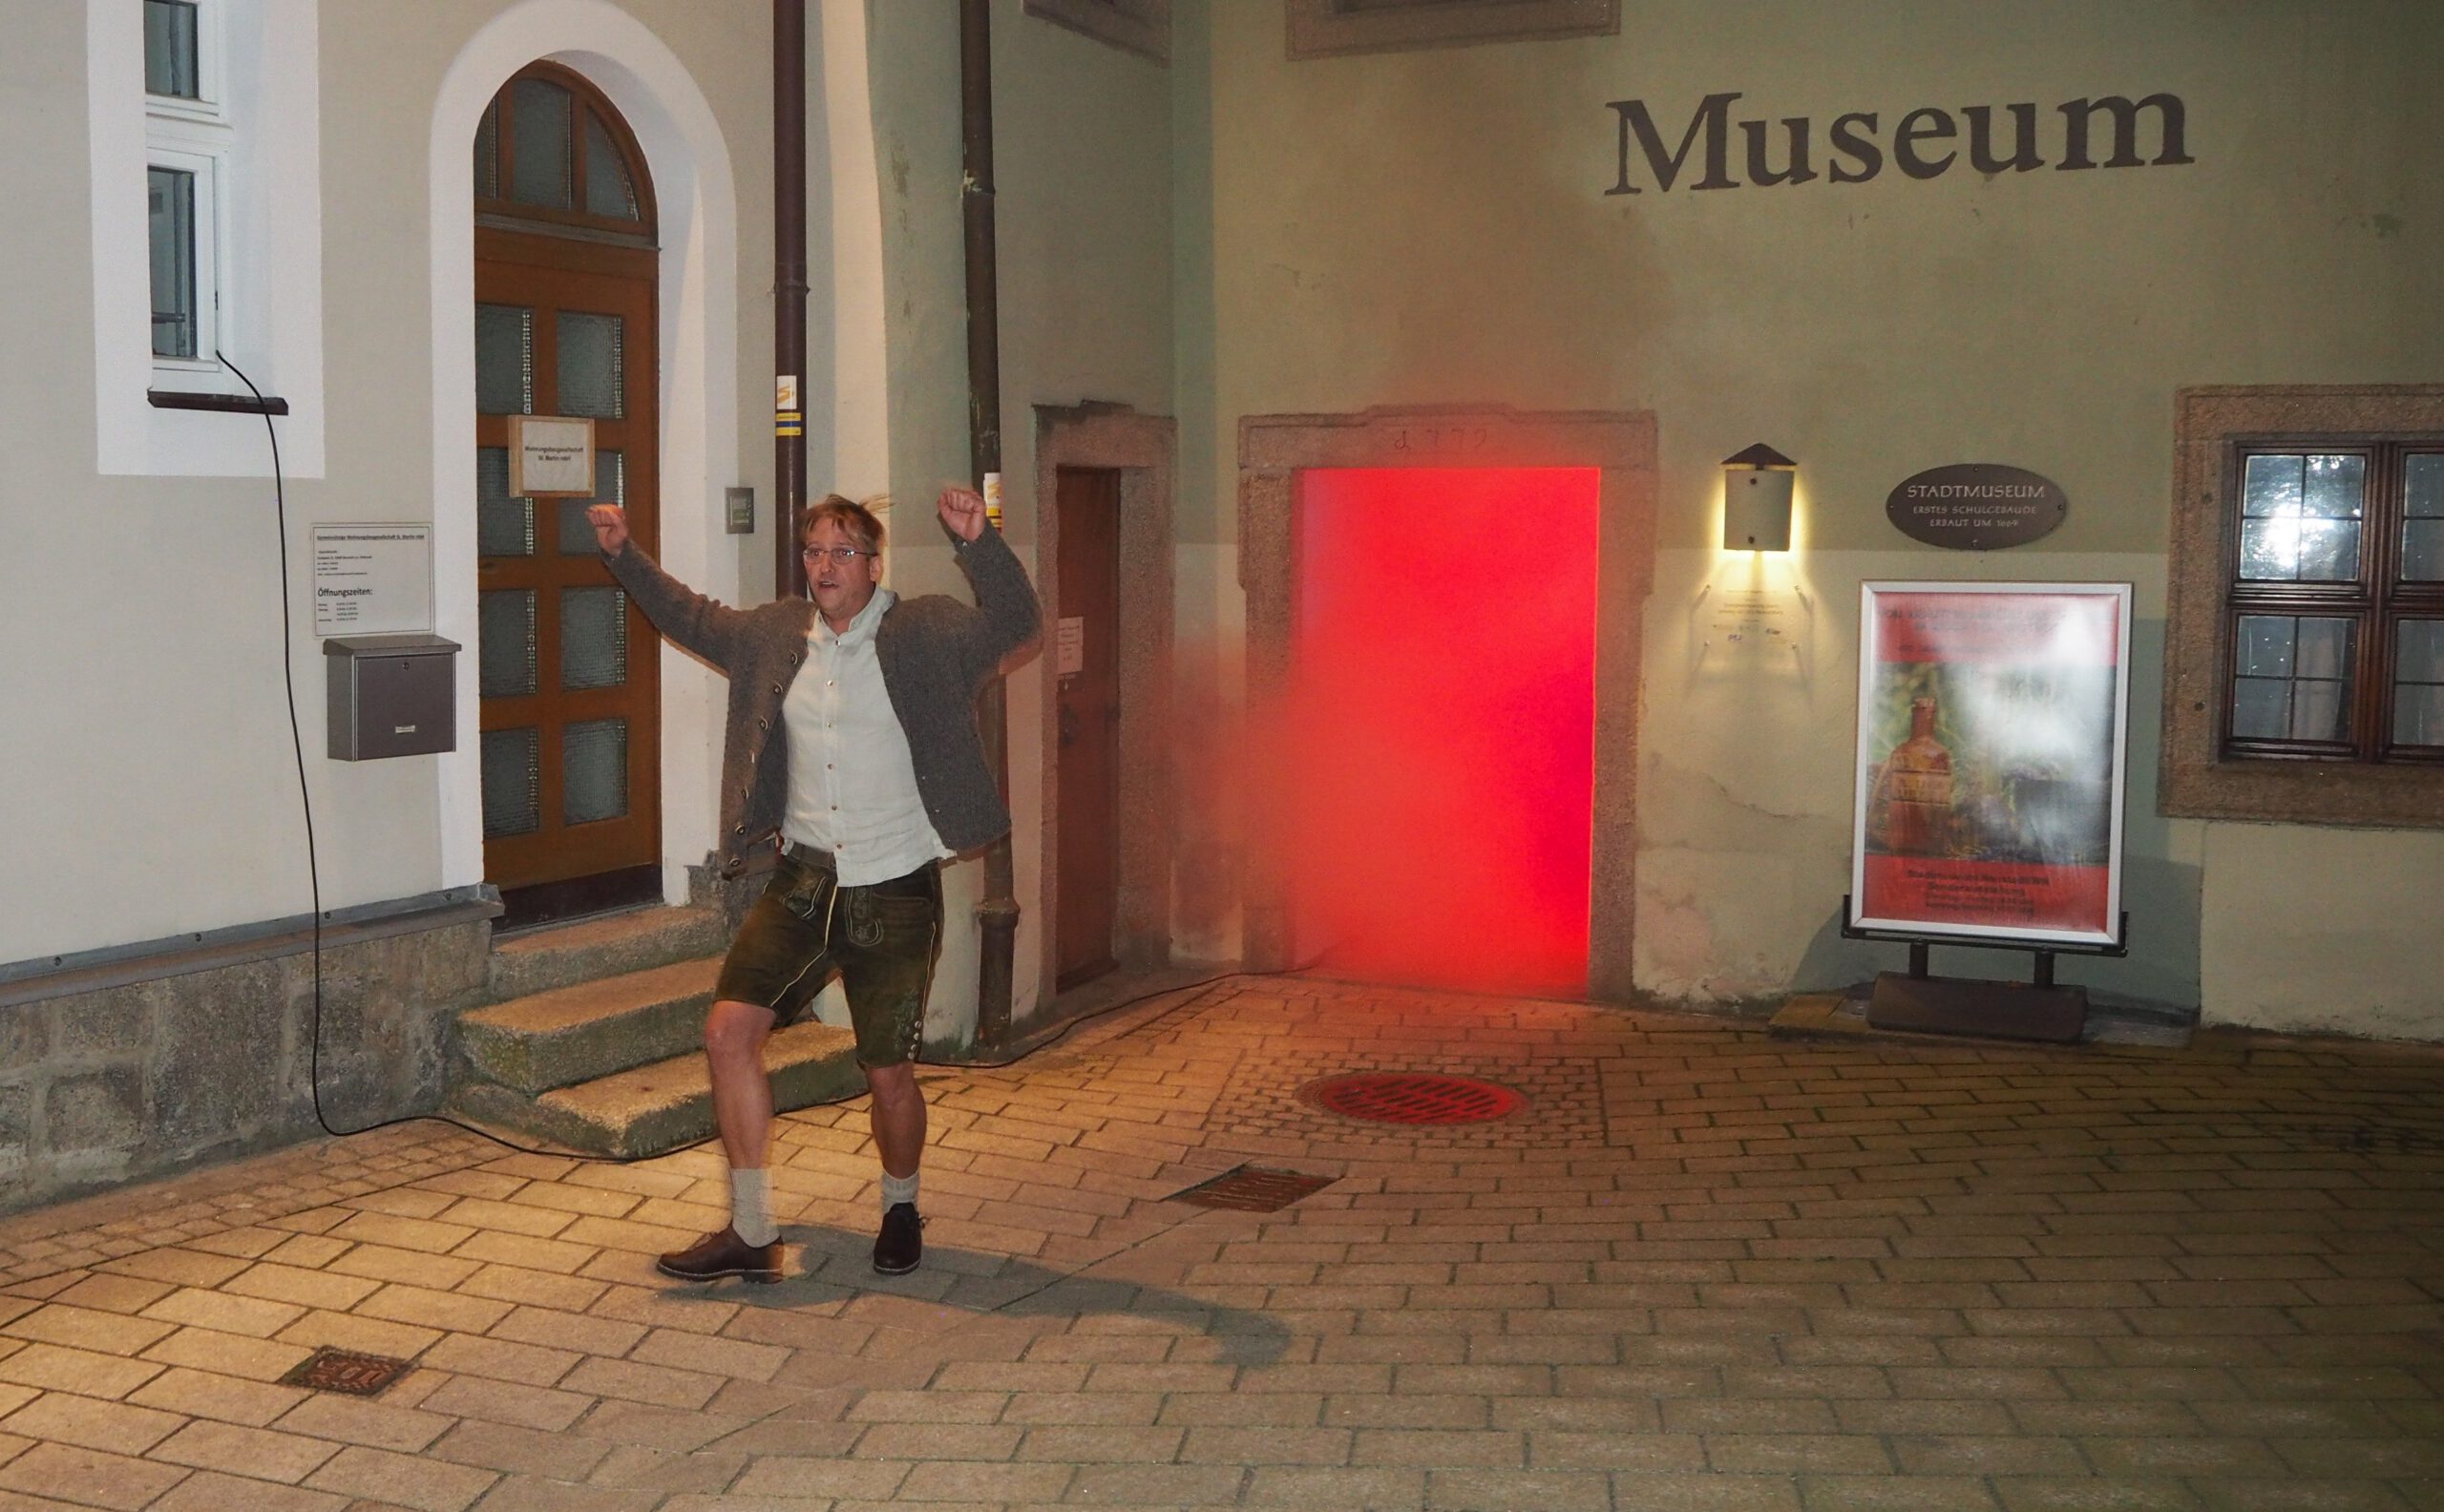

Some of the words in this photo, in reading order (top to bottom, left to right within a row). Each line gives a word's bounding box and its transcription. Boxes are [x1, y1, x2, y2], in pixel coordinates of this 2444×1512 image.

[1604, 93, 2196, 196] Museum
[1907, 485, 2046, 498] STADTMUSEUM
[318, 586, 372, 598] Öffnungszeiten:
